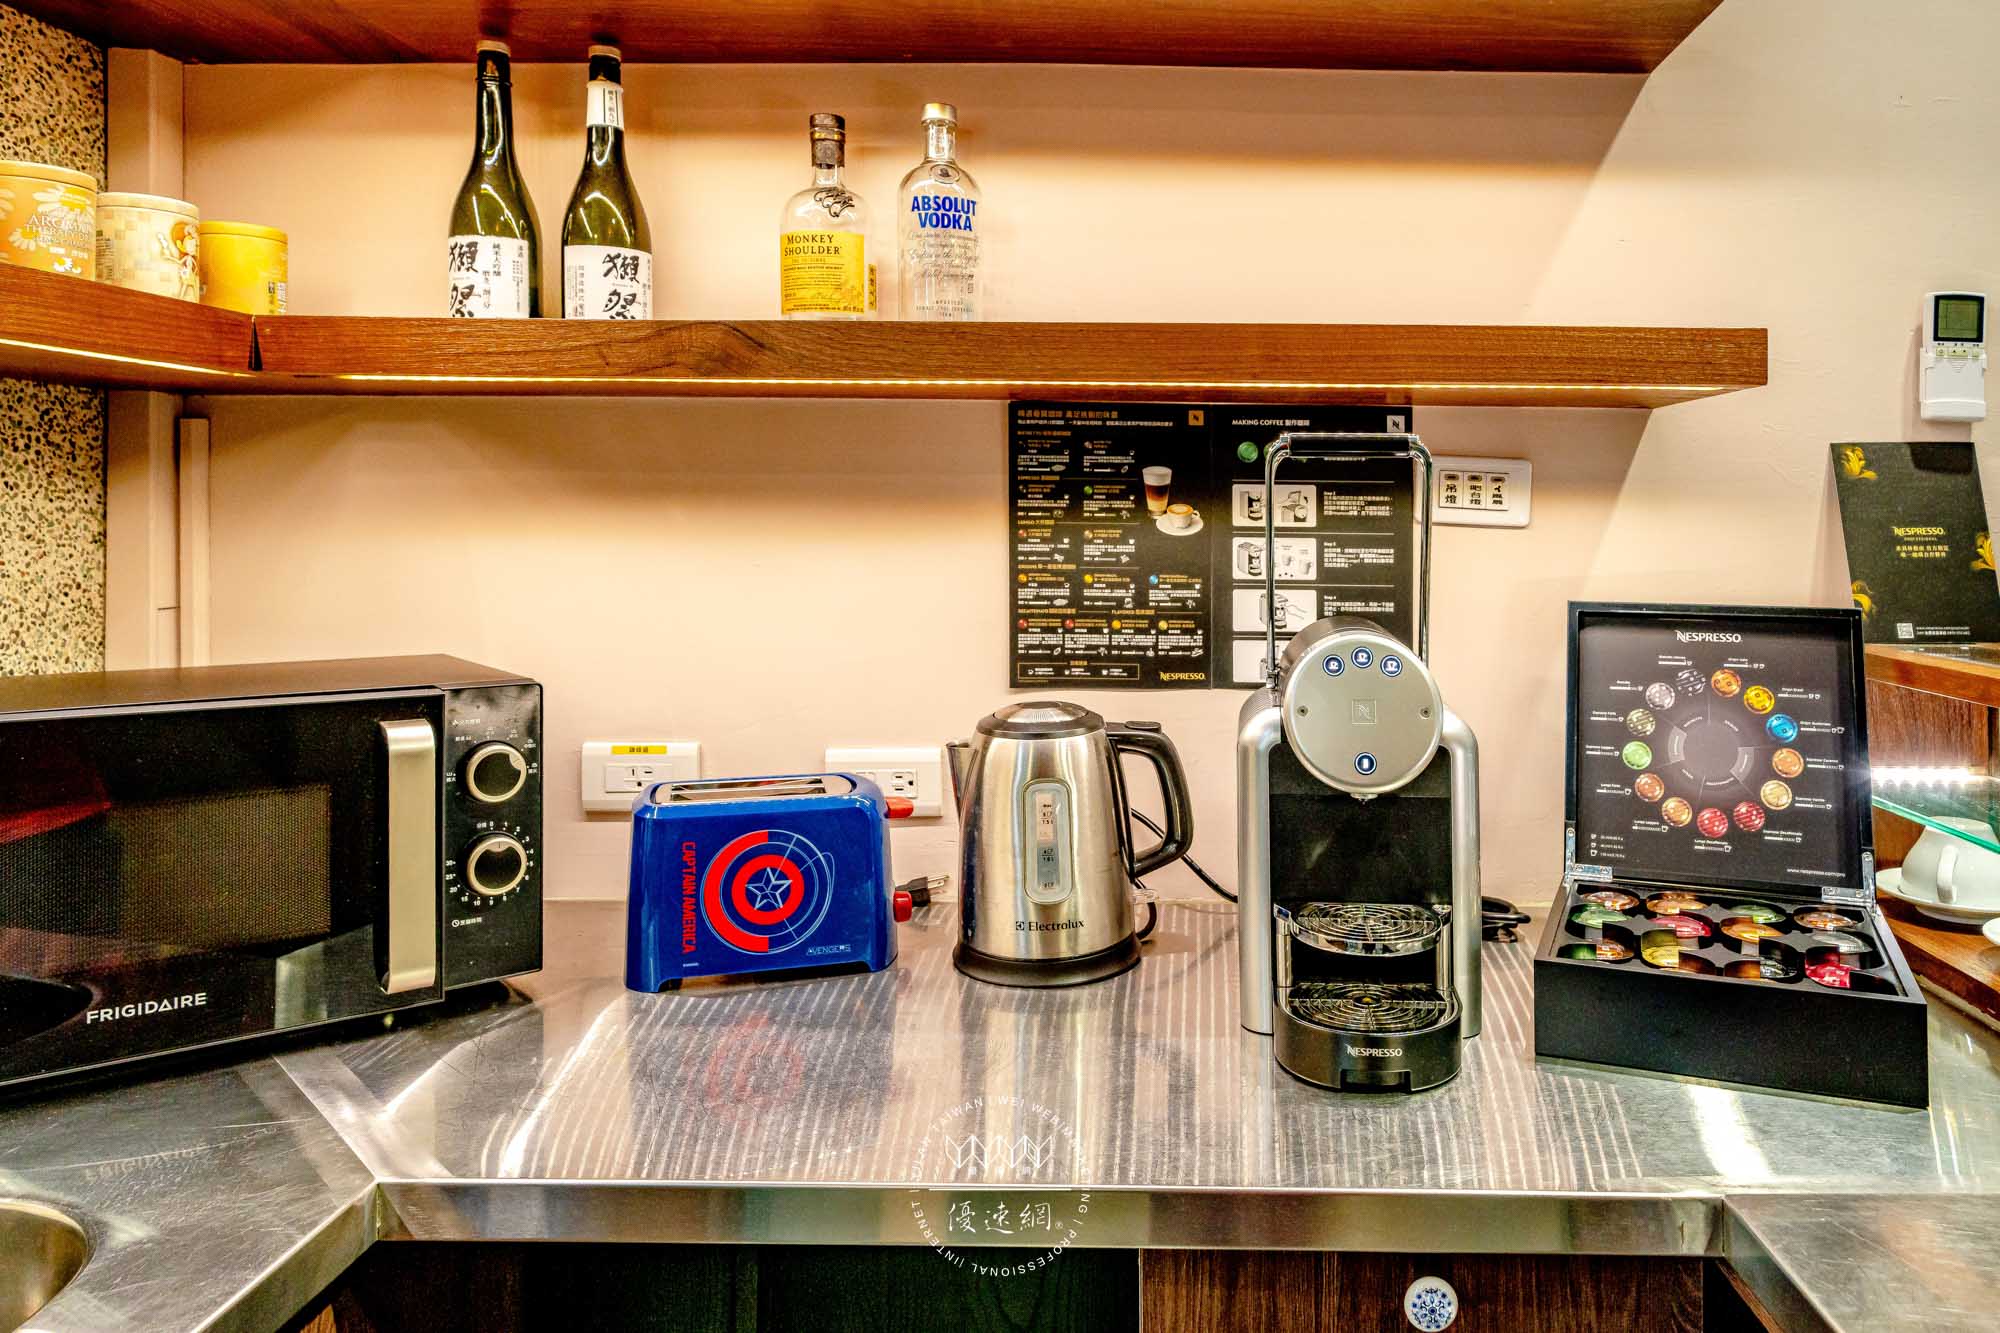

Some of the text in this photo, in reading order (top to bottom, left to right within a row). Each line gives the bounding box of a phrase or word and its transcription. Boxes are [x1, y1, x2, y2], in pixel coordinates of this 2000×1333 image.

[911, 195, 977, 216] ABSOLUT
[918, 211, 973, 231] VODKA
[787, 234, 834, 245] MONKEY
[784, 245, 840, 256] SHOULDER
[1892, 526, 1945, 536] NESPRESSO
[1674, 630, 1742, 643] NESPRESSO
[1160, 671, 1205, 682] NESPRESSO
[682, 841, 697, 954] CAPTAIN AMERICA
[1029, 920, 1085, 931] Electrolux
[806, 943, 852, 956] AVENGERS
[86, 992, 207, 1025] FRIGIDAIRE
[1344, 1043, 1403, 1057] NESPRESSO
